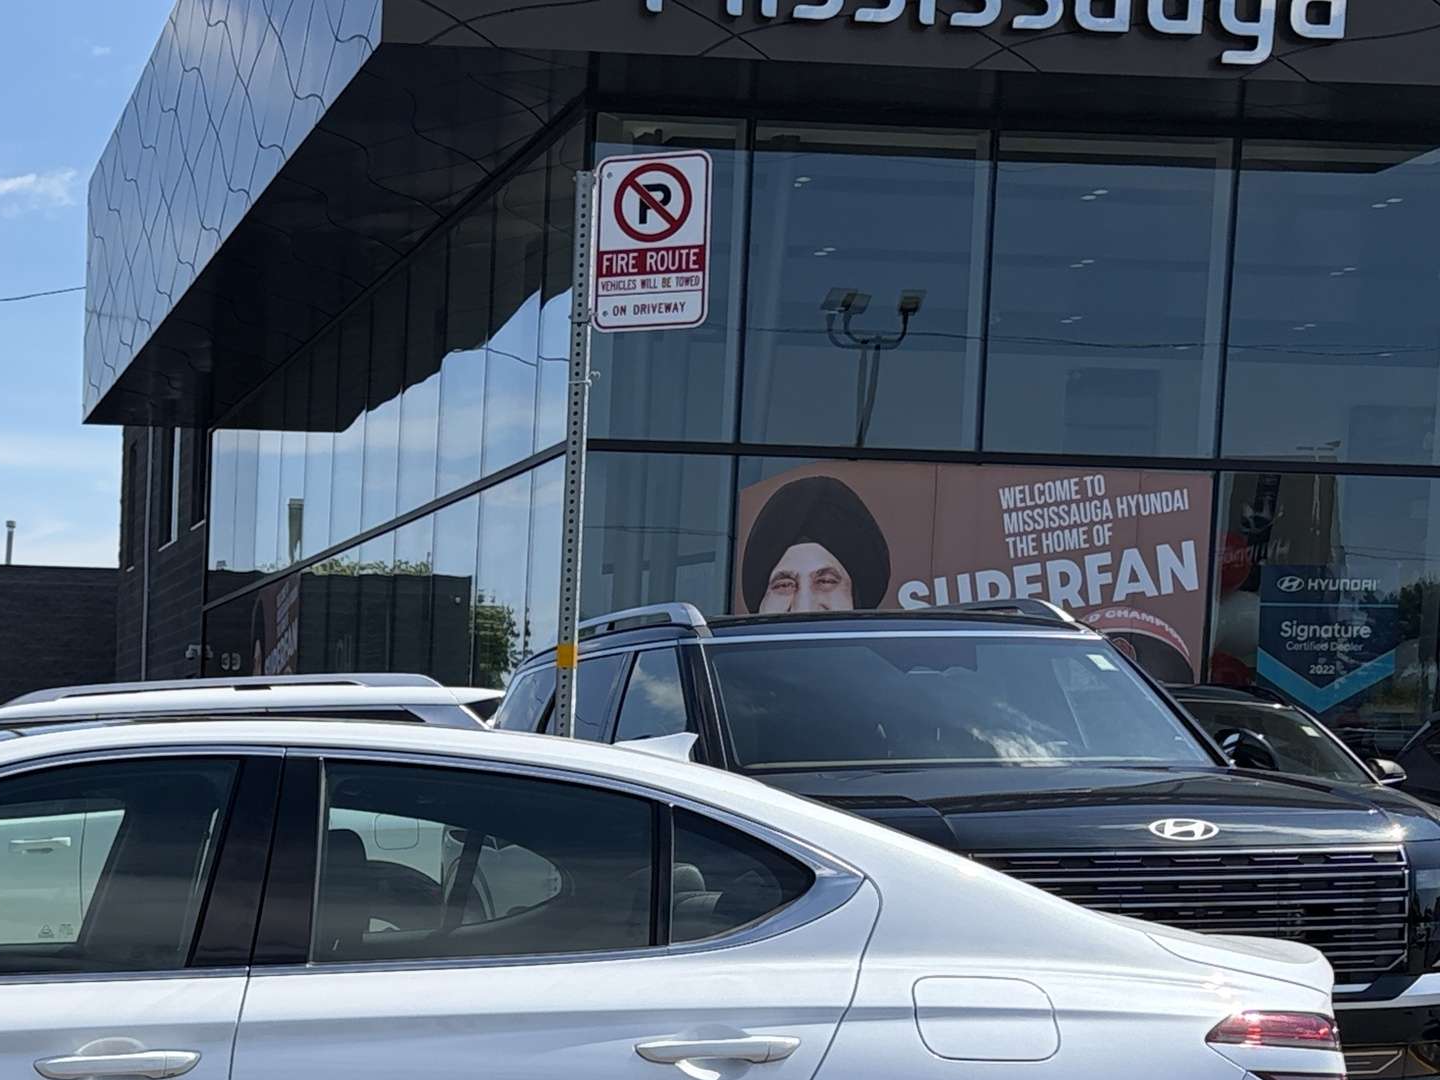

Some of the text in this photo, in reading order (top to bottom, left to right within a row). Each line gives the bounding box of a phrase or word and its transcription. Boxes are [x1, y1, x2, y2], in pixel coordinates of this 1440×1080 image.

[602, 248, 699, 274] FIRE ROUTE
[600, 275, 700, 292] VEHICLES WILL BE TOWED
[612, 301, 686, 317] ON DRIVEWAY
[999, 474, 1106, 510] WELCOME TO
[1002, 488, 1189, 535] MISSISSAUGA HYUNDAI
[1005, 523, 1113, 559] THE HOME OF
[897, 540, 1199, 610] SUPERFAN
[1307, 579, 1377, 591] HYUNDAI
[1280, 620, 1372, 640] Signature
[1286, 641, 1329, 652] Certified
[1309, 664, 1336, 675] 2022
